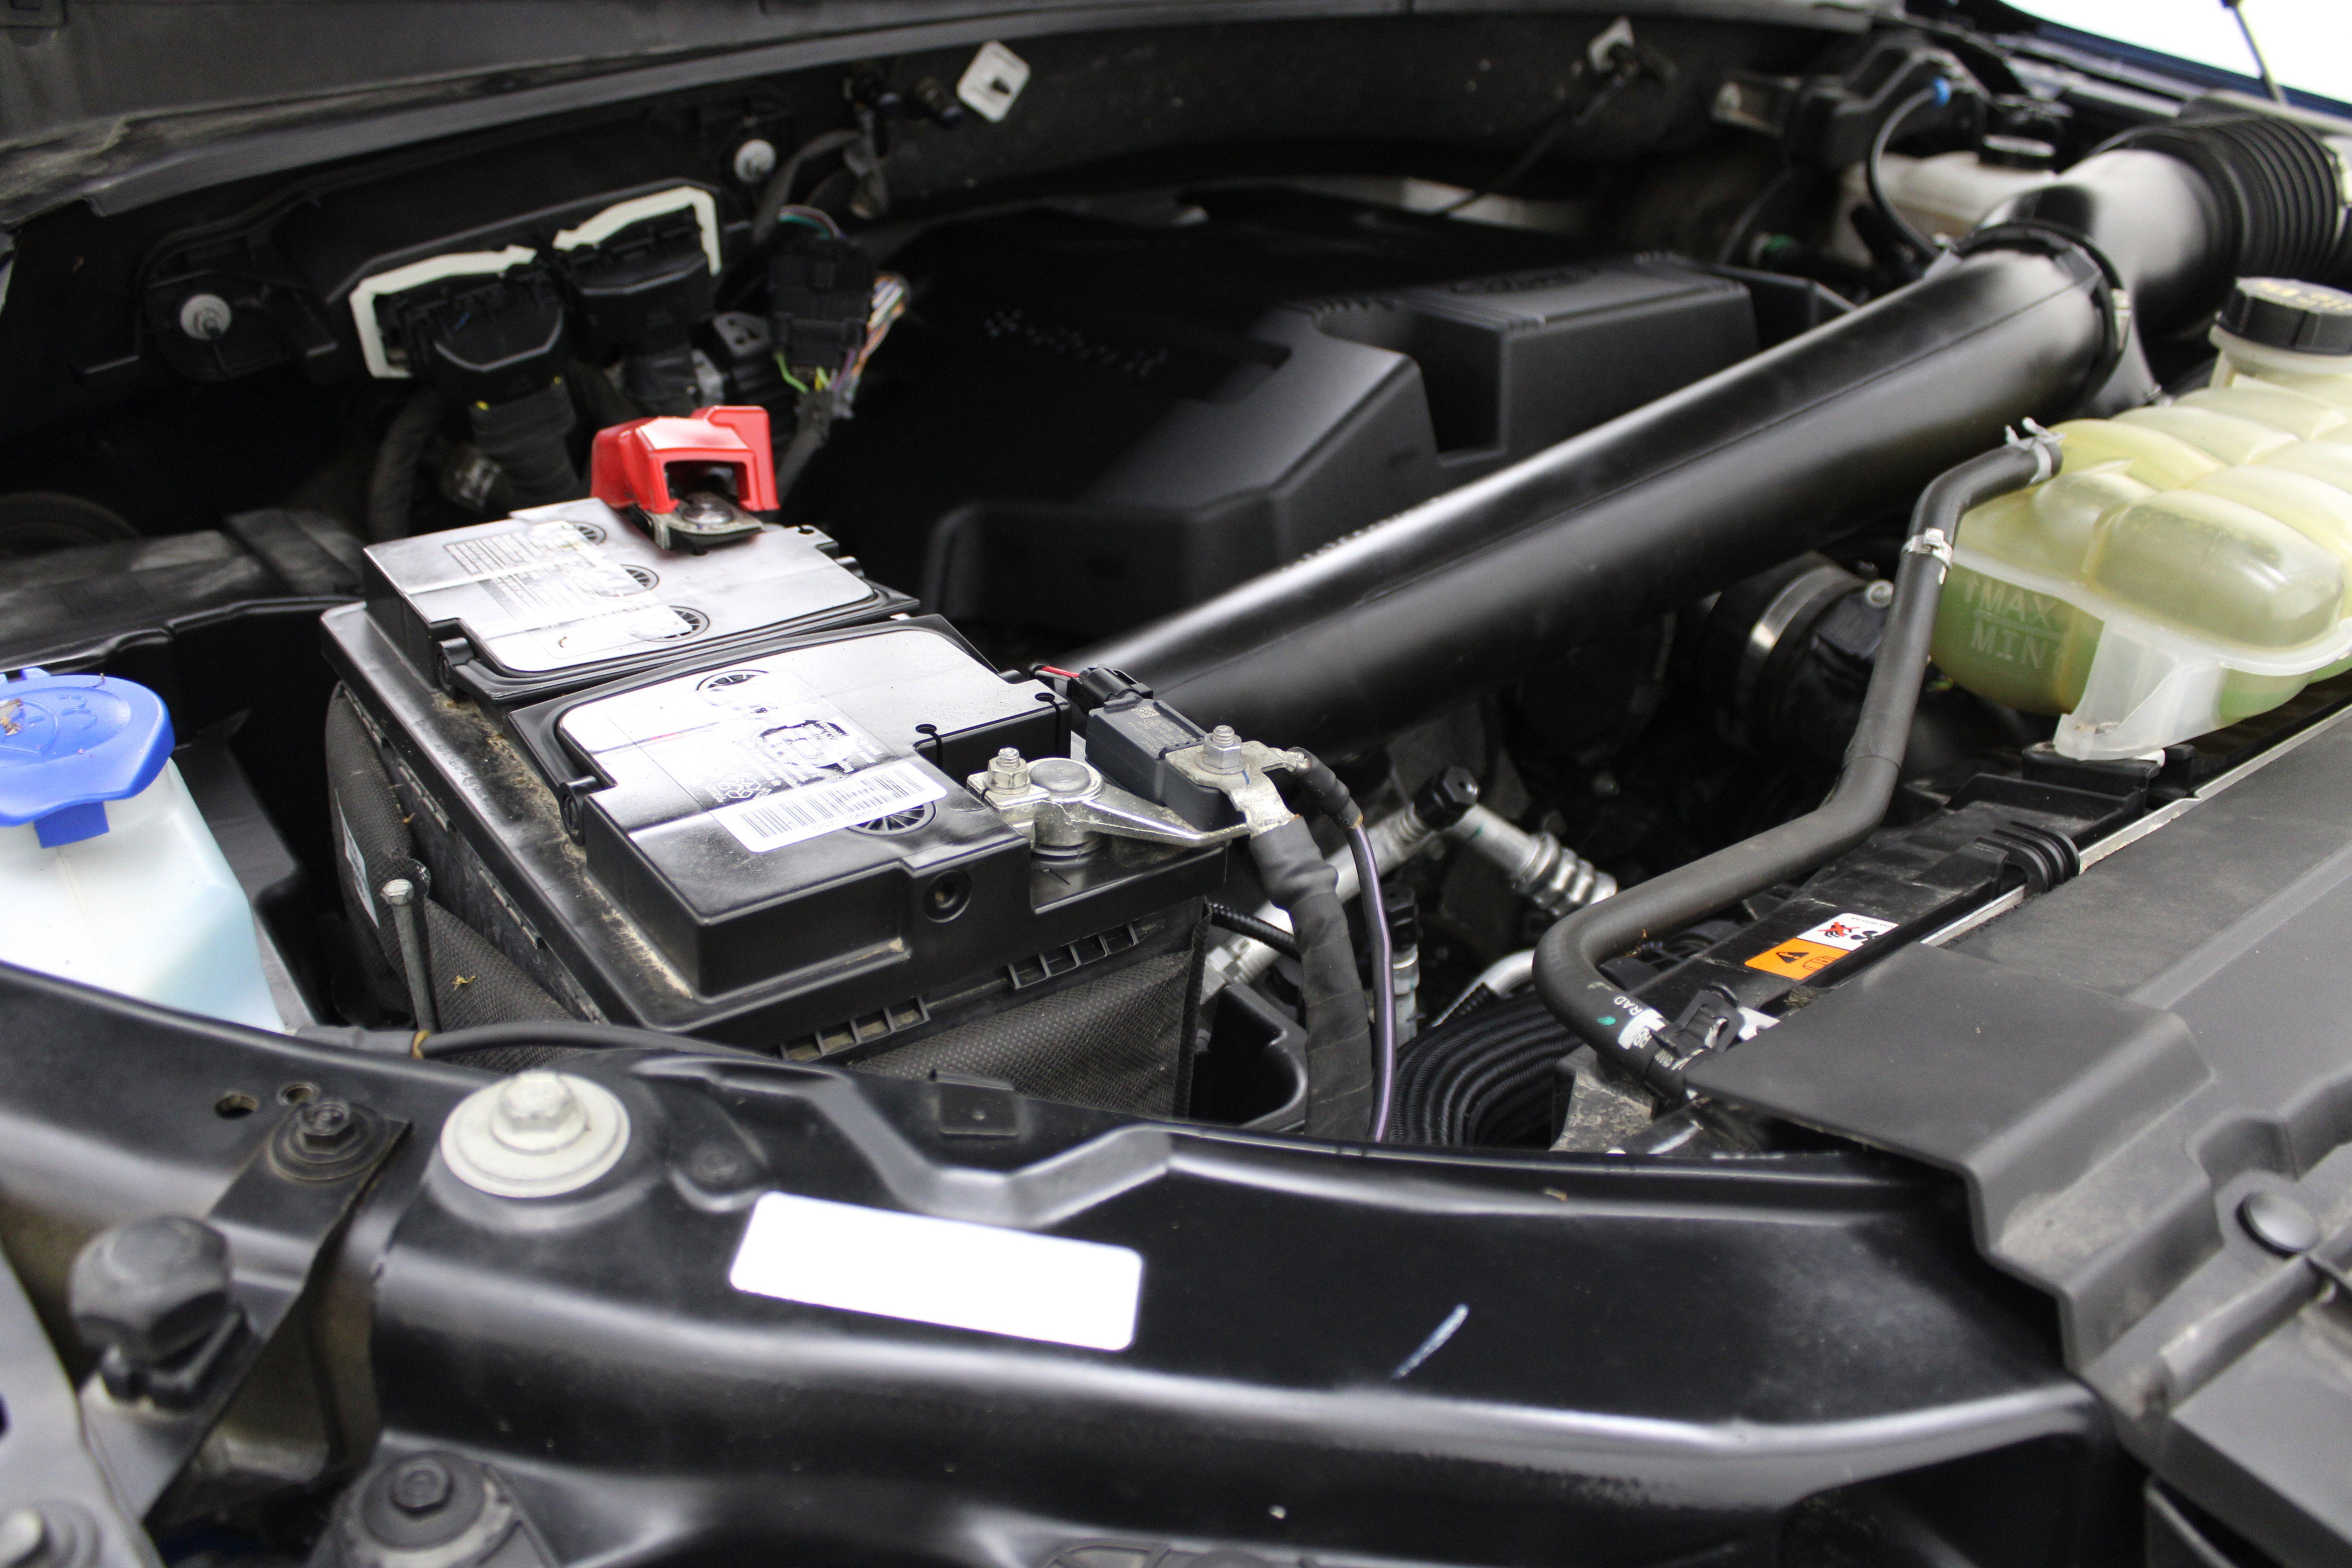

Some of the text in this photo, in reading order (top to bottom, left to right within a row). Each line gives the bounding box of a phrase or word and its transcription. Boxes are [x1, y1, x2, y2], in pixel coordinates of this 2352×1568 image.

[1978, 578, 2058, 628] MAX
[1970, 619, 2048, 670] MIN
[1614, 996, 1643, 1016] RAD
